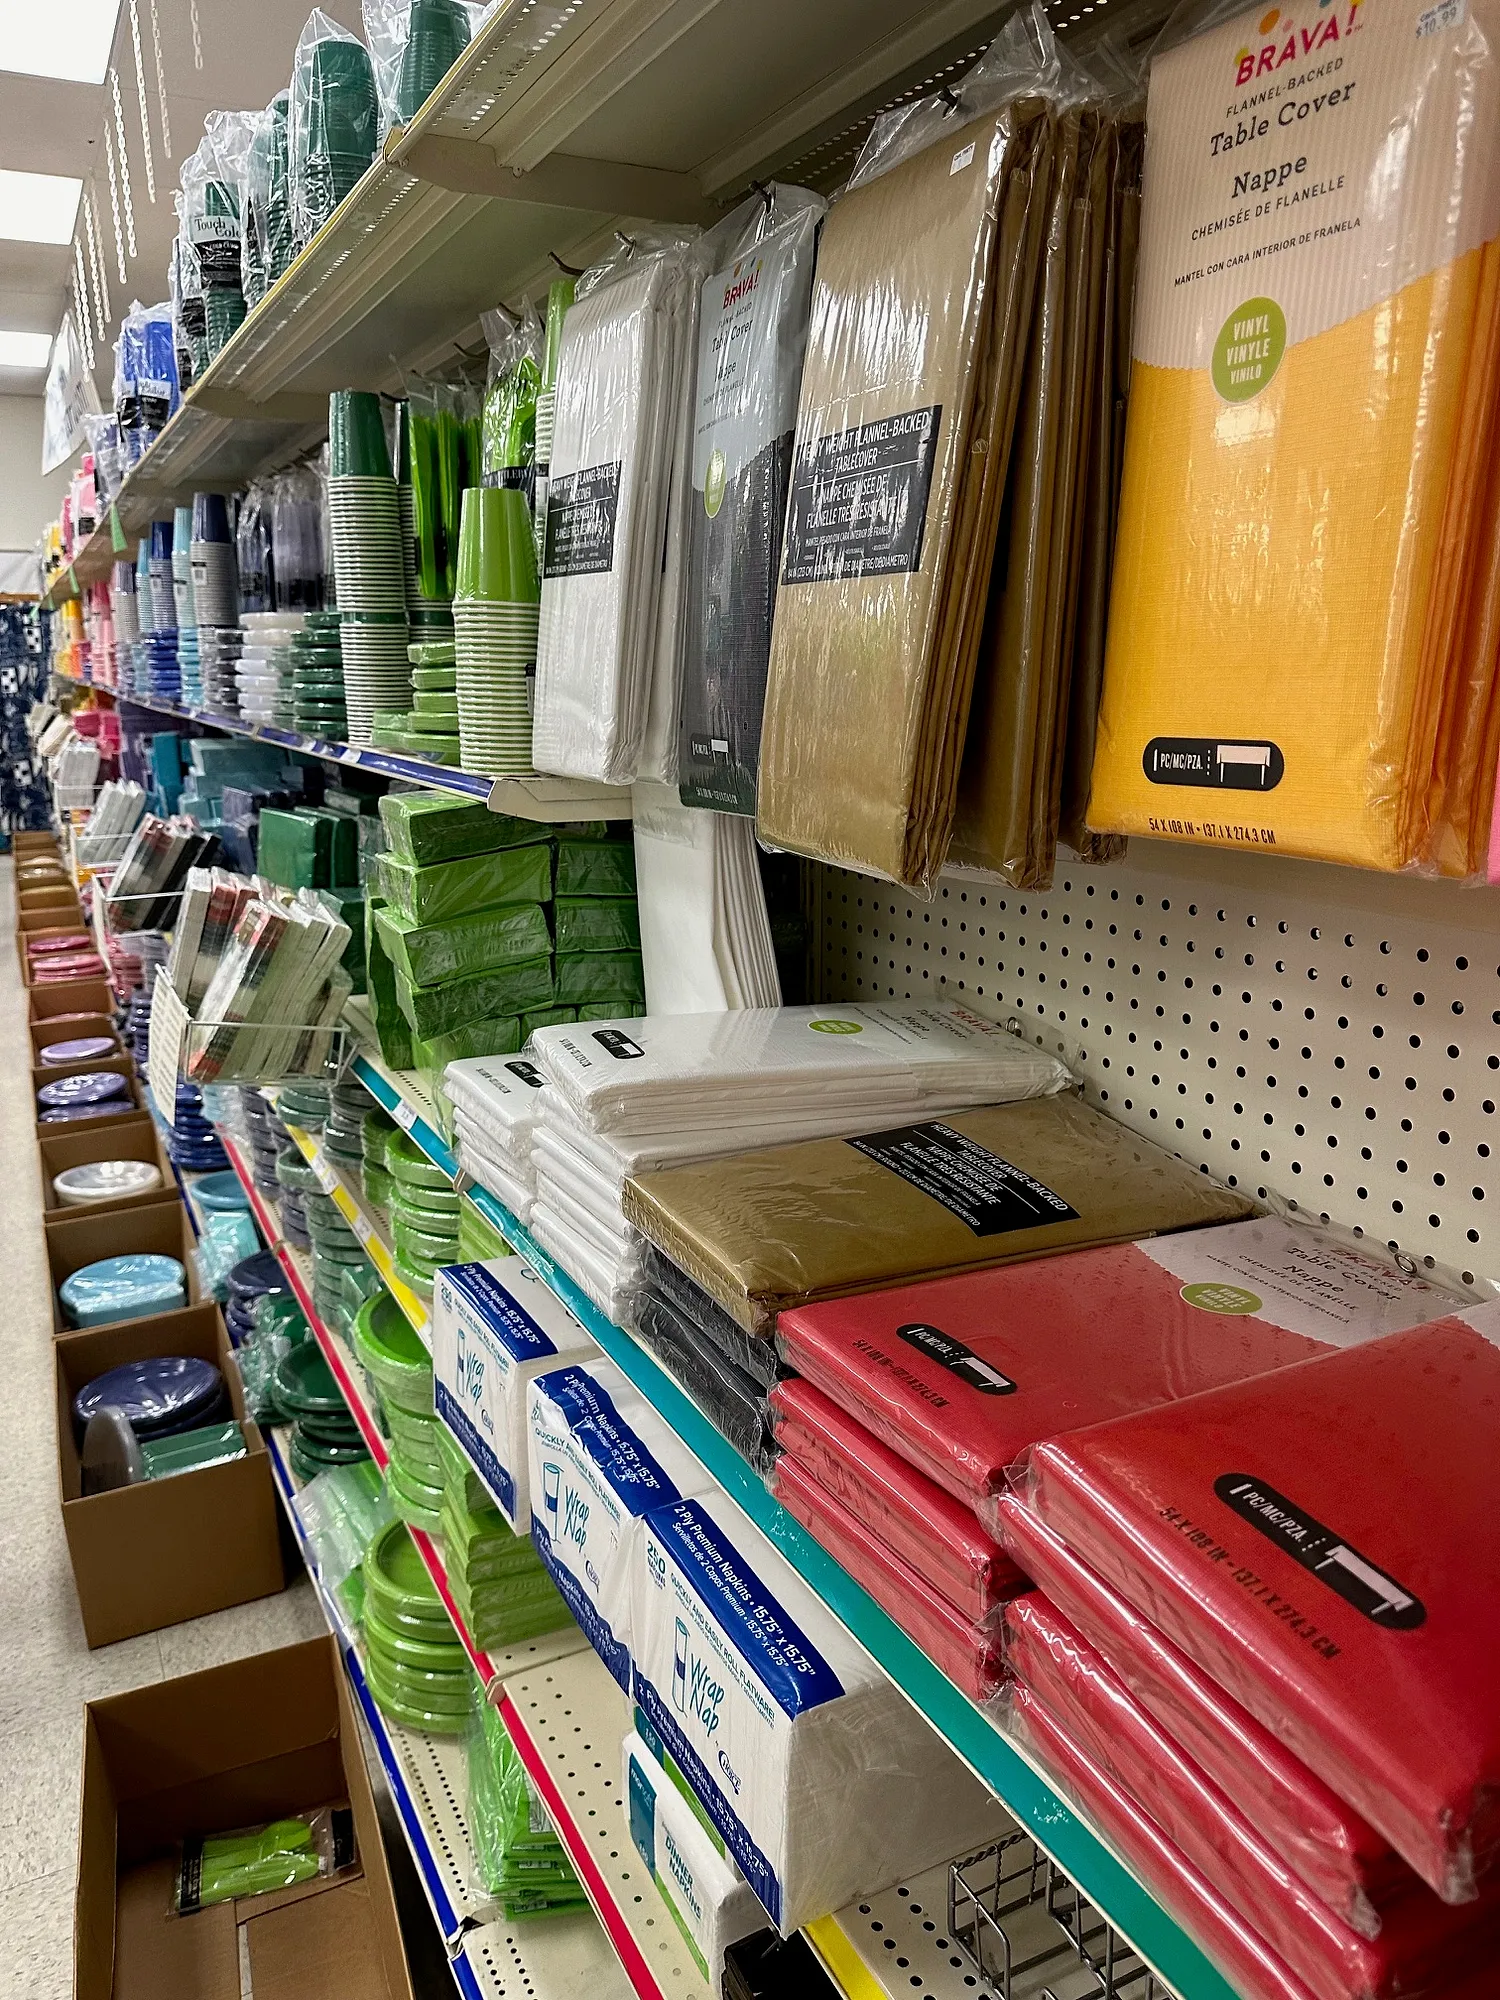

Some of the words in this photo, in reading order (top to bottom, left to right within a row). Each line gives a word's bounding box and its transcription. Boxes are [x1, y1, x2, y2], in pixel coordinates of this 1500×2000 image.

[1235, 4, 1359, 87] BRAVA!
[1225, 57, 1344, 118] FLANNEL-BACKED
[1211, 117, 1269, 157] Table
[1277, 81, 1356, 127] Cover
[1231, 155, 1307, 199] Nappe
[195, 217, 226, 231] Touch
[1191, 208, 1251, 241] CHEMISÉE
[1255, 201, 1271, 218] DE
[1276, 175, 1345, 210] FLANELLE
[1174, 268, 1205, 287] MANTEL
[1207, 262, 1224, 275] CON
[1226, 253, 1250, 269] CARA
[1252, 237, 1296, 260] INTERIOR
[1299, 232, 1311, 245] DE
[1314, 218, 1361, 241] FRANELA
[722, 269, 760, 310] BRAVA!
[731, 320, 753, 341] Cover
[1226, 338, 1270, 366] VINYLE
[1233, 314, 1269, 341] VINYL
[1230, 366, 1262, 385] VINILO
[834, 447, 878, 474] TABLECOVER
[1160, 752, 1204, 770] PC/MC/PZA.
[1149, 817, 1160, 831] 54
[1160, 819, 1168, 832] X
[1168, 820, 1183, 834] 108
[1185, 821, 1195, 835] IN
[1202, 823, 1224, 838] 137.1
[1225, 825, 1233, 839] X
[1234, 826, 1259, 842] 274.3
[1260, 829, 1276, 844] CM
[926, 1145, 953, 1162] NAPPE
[986, 1180, 1003, 1192] DE
[930, 1124, 961, 1139] HEAVY
[956, 1137, 990, 1159] WEIGHT
[988, 1155, 1069, 1211] FLANNEL-BACKED
[957, 1149, 1008, 1180] TABLECOVER
[1206, 1254, 1232, 1268] MANTEL
[1232, 1267, 1248, 1276] CON
[1248, 1274, 1269, 1286] CARA
[1269, 1285, 1302, 1302] INTERIOR
[1311, 1305, 1350, 1324] FRANELA
[1239, 1254, 1290, 1279] CHEMISÉE
[1289, 1279, 1301, 1287] DE
[1305, 1286, 1361, 1311] FLANELLE
[1283, 1265, 1344, 1294] Nappe
[1287, 1247, 1336, 1271] Table
[1342, 1272, 1401, 1300] Cover
[564, 1485, 590, 1528] Wrap
[564, 1513, 588, 1553] Nap
[1243, 1490, 1309, 1544] PC/MC/PZA.
[647, 1540, 667, 1575] 250
[672, 1521, 699, 1554] Servilletas
[694, 1550, 704, 1561] de
[699, 1559, 710, 1569] 2
[705, 1565, 724, 1588] Copas
[720, 1584, 746, 1618] Premium
[673, 1505, 686, 1514] 2
[680, 1510, 695, 1527] Ply
[689, 1522, 723, 1565] Premium
[719, 1561, 752, 1602] Napkins
[776, 1636, 788, 1645] x
[1159, 1506, 1178, 1523] 54
[1174, 1518, 1191, 1531] X
[1185, 1527, 1214, 1550] 108
[1208, 1545, 1230, 1565] IN
[1231, 1566, 1269, 1597] 137.1
[1262, 1592, 1281, 1606] X
[1273, 1600, 1316, 1640] 274.3
[1311, 1634, 1342, 1660] CM
[670, 1572, 692, 1604] QUICKLY
[691, 1603, 705, 1625] AND
[704, 1619, 724, 1651] EASILY
[723, 1646, 739, 1675] ROLL
[739, 1670, 776, 1722] FLATWARE!
[638, 1683, 645, 1696] 2
[690, 1652, 725, 1711] Wrap
[689, 1681, 719, 1738] Nap
[665, 1835, 694, 1891] DINNER
[669, 1856, 702, 1920] NAPKINS
